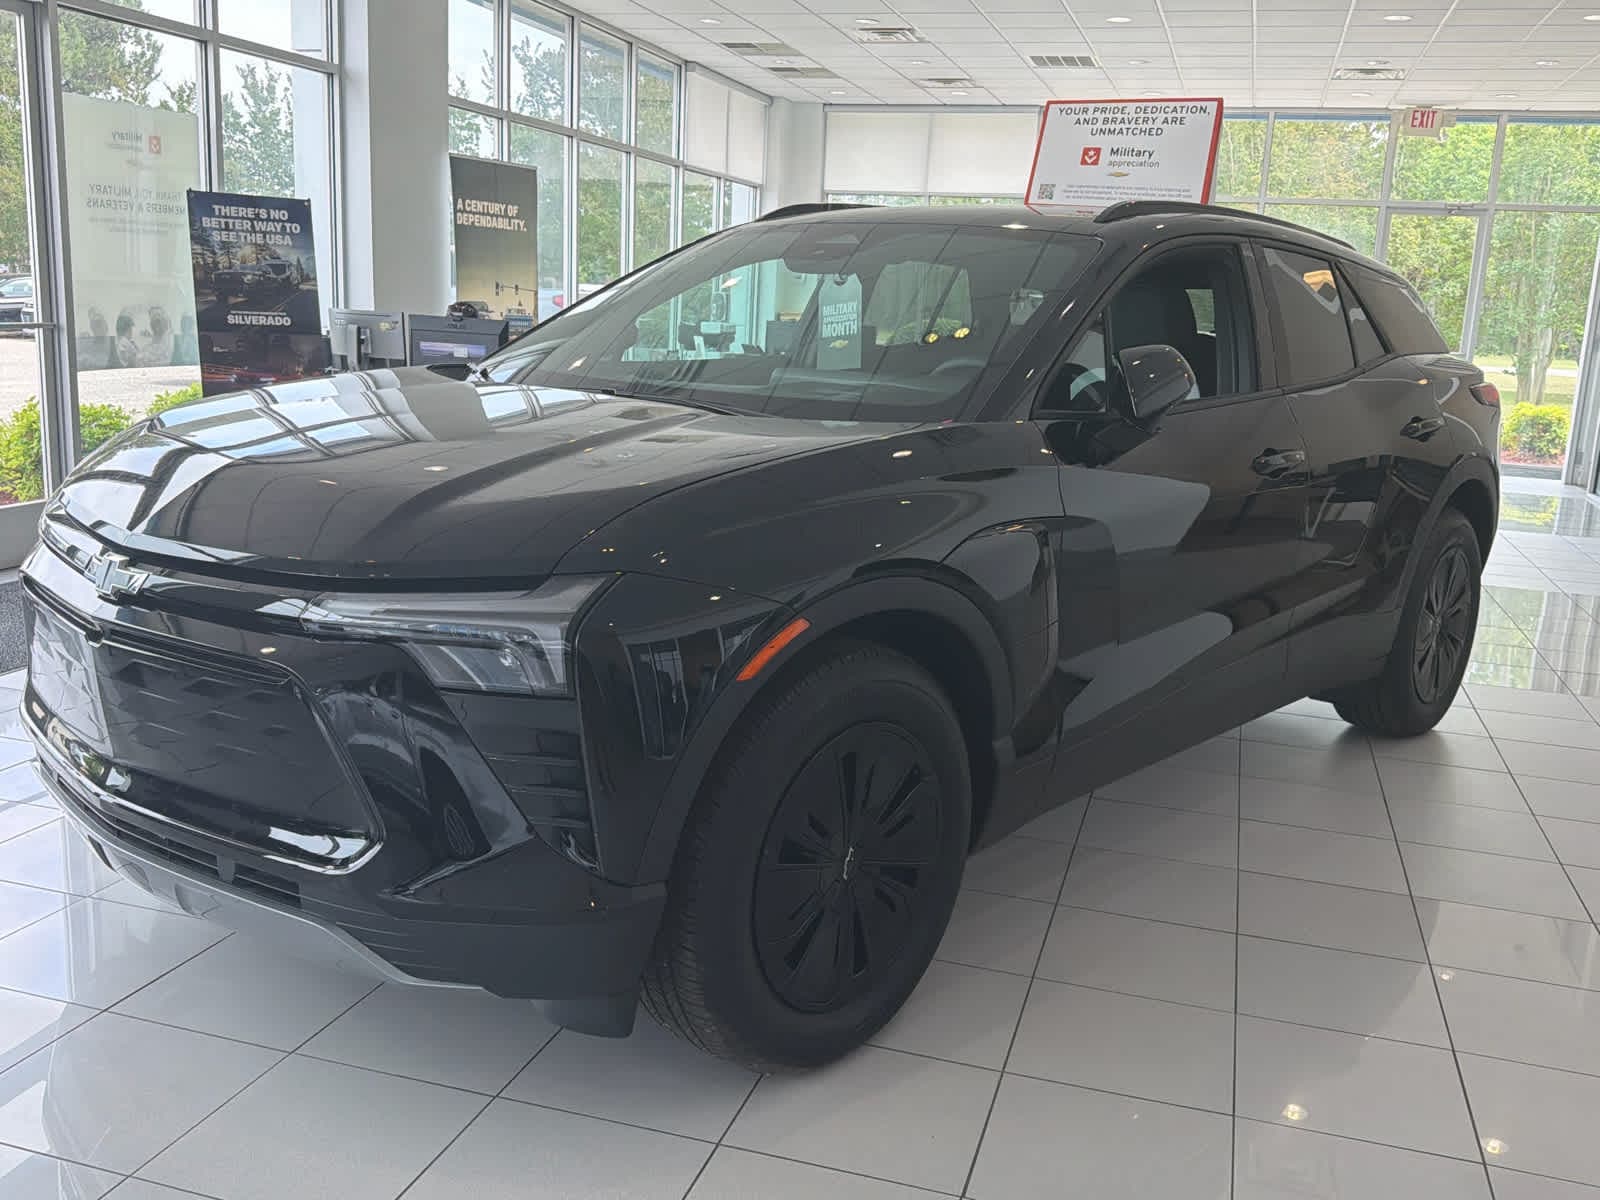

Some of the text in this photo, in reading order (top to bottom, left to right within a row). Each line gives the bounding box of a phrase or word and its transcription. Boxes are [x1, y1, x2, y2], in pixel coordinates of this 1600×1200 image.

[1058, 105, 1211, 116] YOUR PRIDE, DEDICATION,
[1074, 116, 1186, 126] AND BRAVERY ARE
[1410, 110, 1438, 129] EXIT
[1090, 127, 1164, 137] UNMATCHED
[1109, 147, 1155, 159] Military
[1107, 158, 1160, 168] appreciation
[212, 205, 289, 220] THERE'S NO
[456, 198, 519, 217] A CENTURY OF
[202, 217, 300, 234] BETTER WAY TO
[456, 212, 527, 232] DEPENDABILITY.
[211, 230, 292, 246] SEE THE USA
[823, 302, 858, 316] MILITARY
[226, 315, 292, 326] SILVERADO
[822, 320, 857, 338] MONTH
